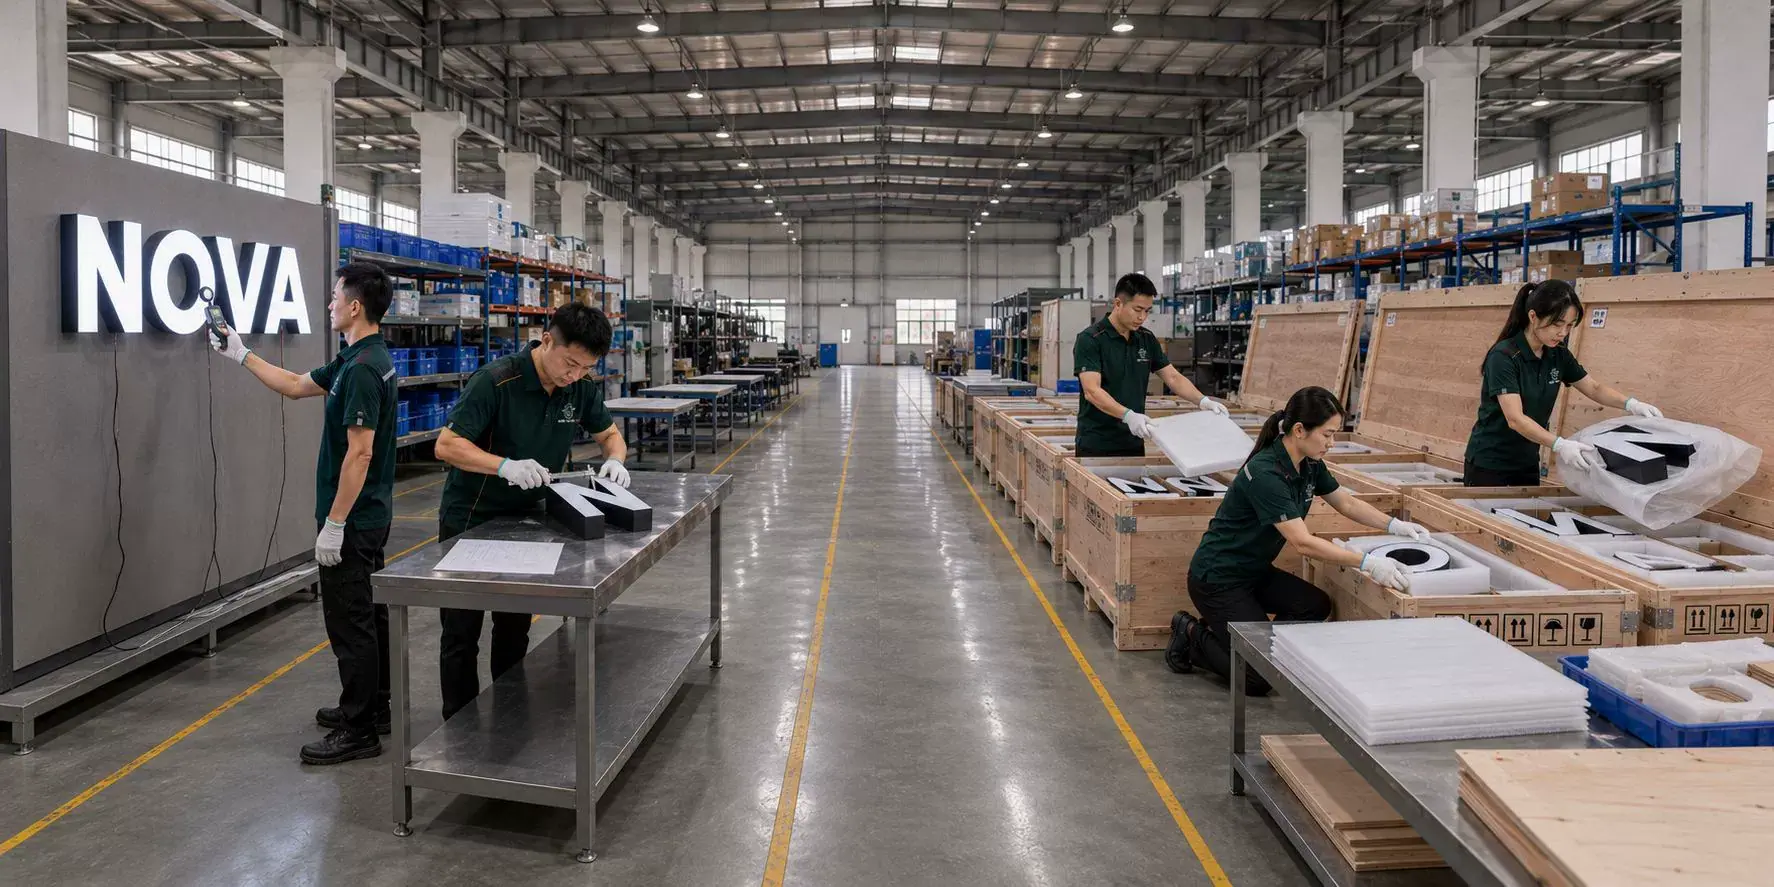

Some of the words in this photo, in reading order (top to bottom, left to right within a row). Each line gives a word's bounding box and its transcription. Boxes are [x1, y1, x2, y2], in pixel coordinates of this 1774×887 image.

[60, 213, 312, 335] NOVA
[547, 477, 653, 533] N
[1367, 541, 1450, 573] O
